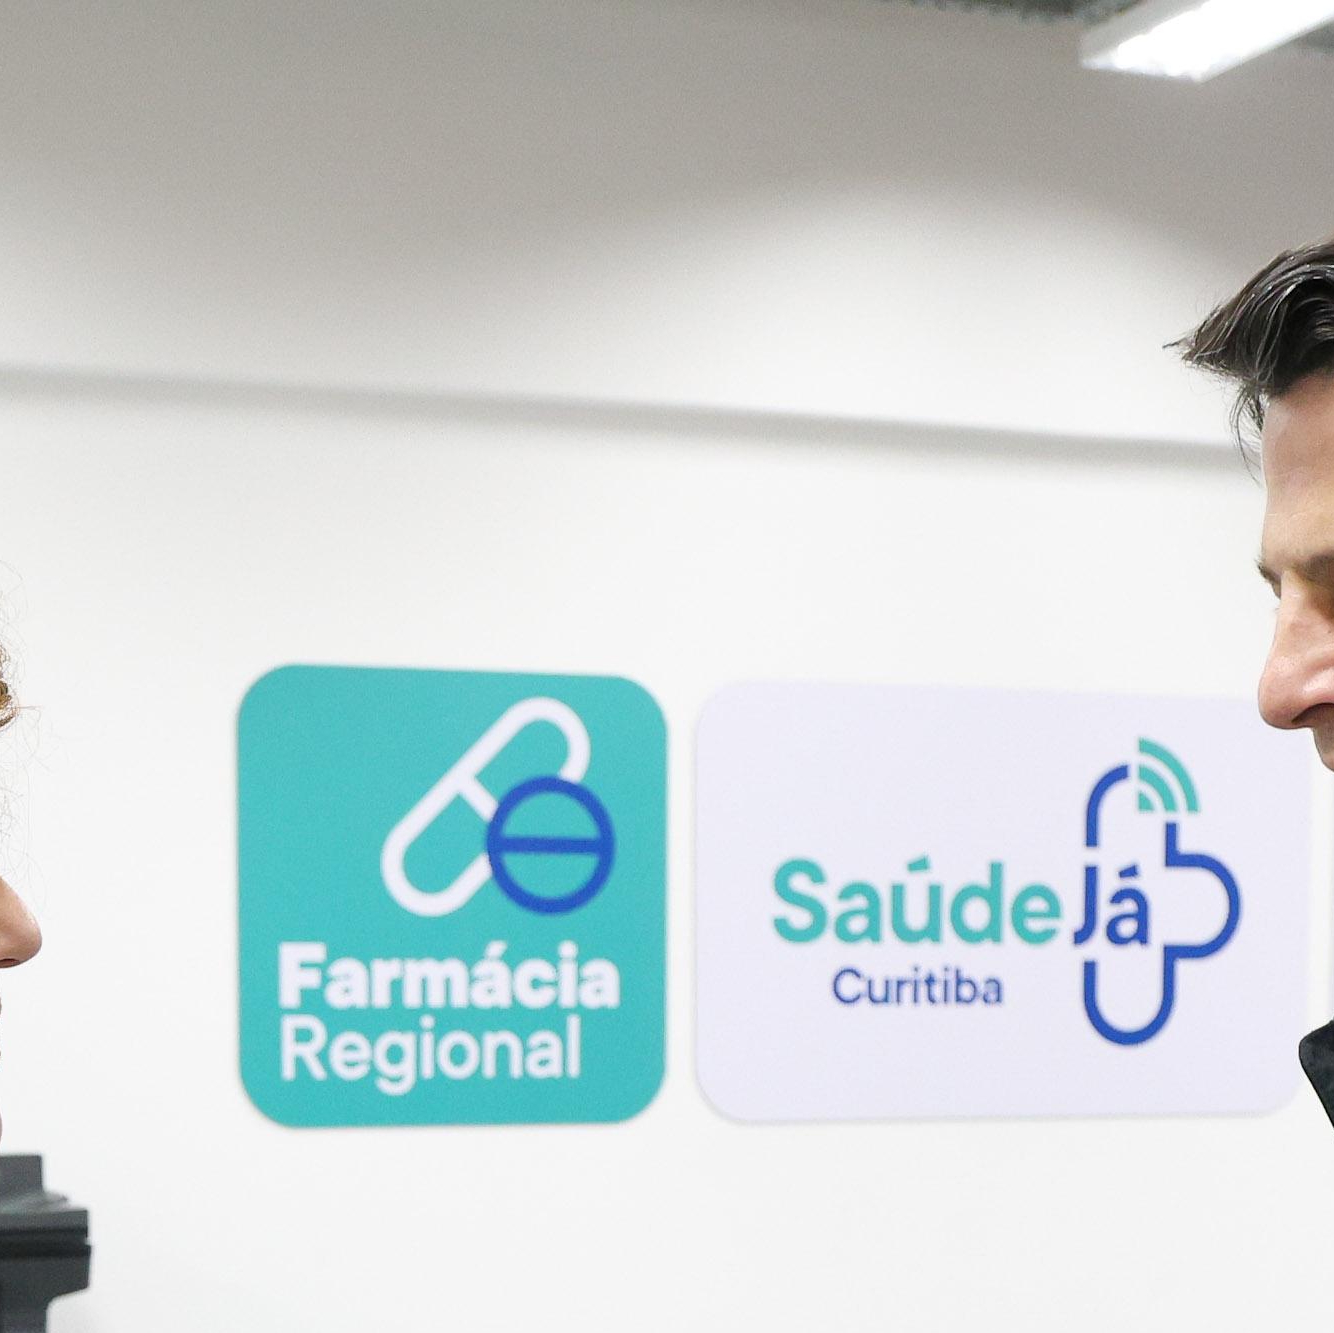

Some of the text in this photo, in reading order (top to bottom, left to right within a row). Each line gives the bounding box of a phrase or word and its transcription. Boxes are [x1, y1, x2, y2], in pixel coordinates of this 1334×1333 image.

[773, 856, 1151, 946] Saúde Já
[279, 940, 620, 1009] Farmácia
[832, 965, 1004, 1007] Curitiba
[281, 1014, 581, 1096] Regional
